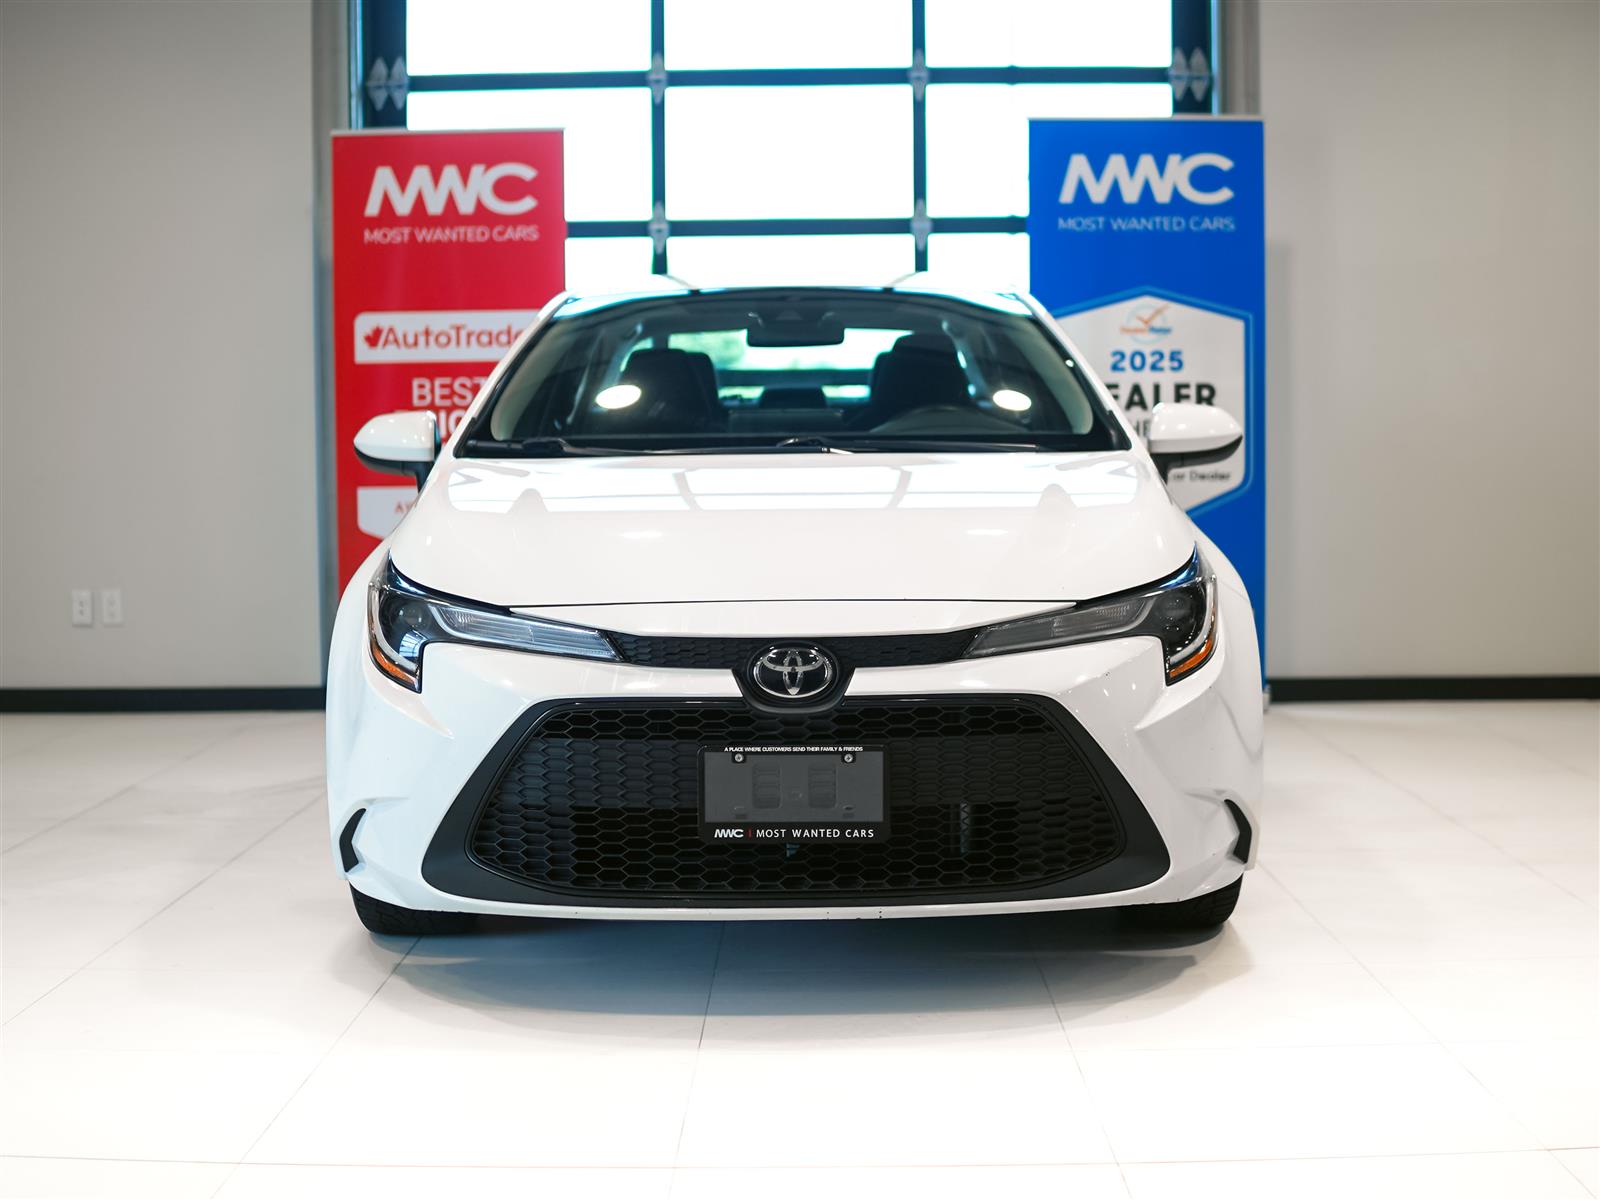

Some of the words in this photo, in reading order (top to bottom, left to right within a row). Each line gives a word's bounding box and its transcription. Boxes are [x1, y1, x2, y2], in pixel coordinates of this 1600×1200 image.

[364, 162, 539, 217] MWC
[1058, 153, 1235, 205] MWC
[363, 228, 412, 244] MOST
[415, 226, 490, 243] WANTED
[492, 225, 539, 242] CARS
[1057, 216, 1105, 232] MOST
[1110, 216, 1185, 232] WANTED
[1189, 216, 1236, 232] CARS
[1110, 350, 1184, 373] 2025
[714, 829, 744, 838] MWC
[756, 829, 786, 838] MOST
[792, 829, 841, 838] WANTED
[845, 829, 874, 838] CARS
